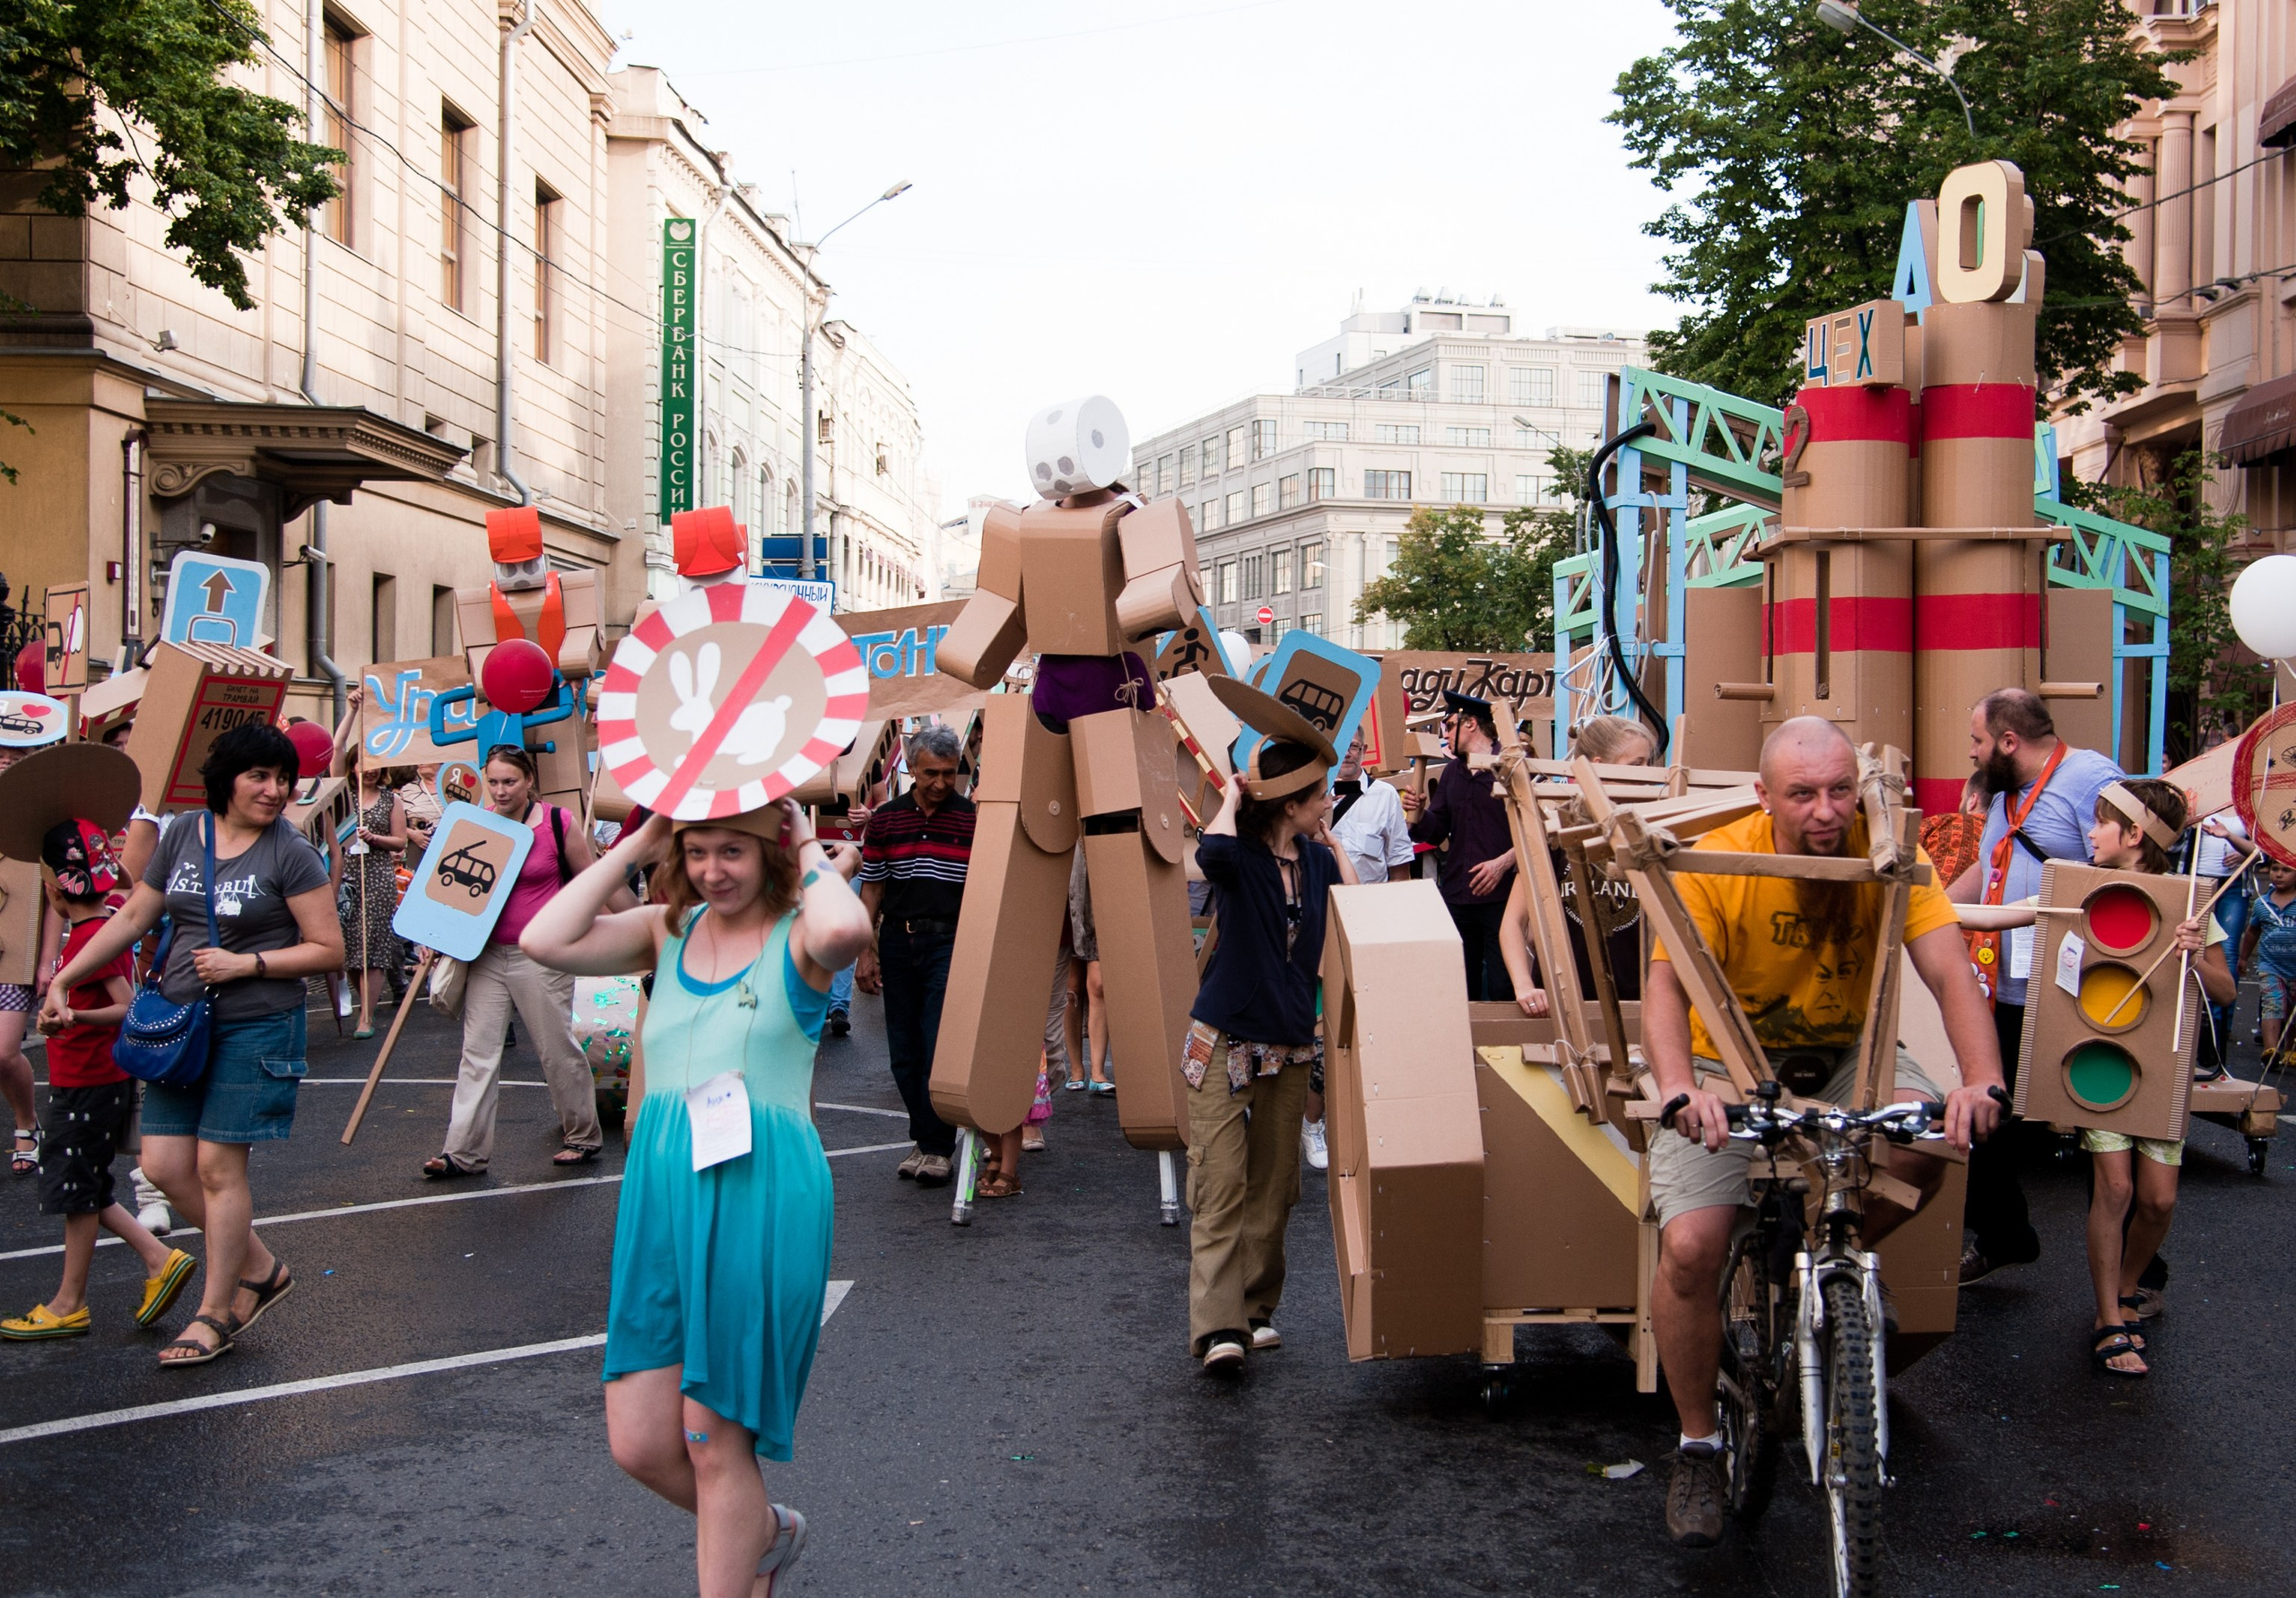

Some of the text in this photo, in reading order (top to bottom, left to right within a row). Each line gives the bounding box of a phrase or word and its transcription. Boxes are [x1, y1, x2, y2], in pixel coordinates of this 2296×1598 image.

[671, 251, 688, 398] СБЕРБАНК
[1806, 308, 1875, 387] ЦЕХ
[1783, 405, 1810, 489] 2
[223, 693, 260, 704] ТРАМВАЙ
[226, 685, 248, 693] БИЛЕТ
